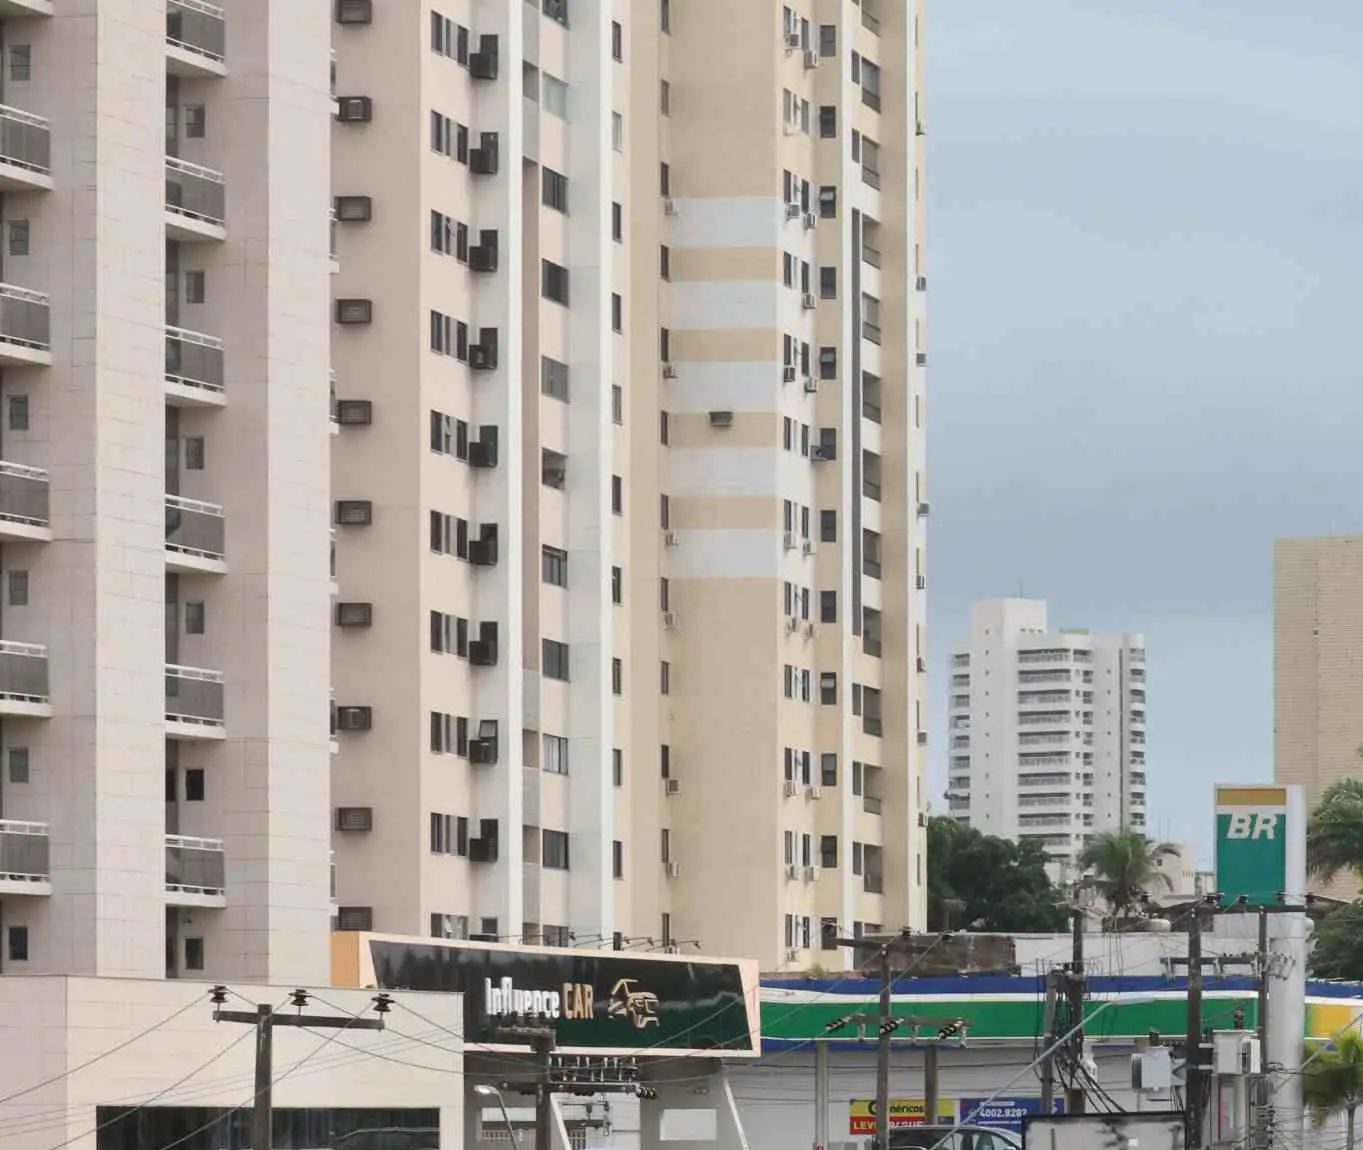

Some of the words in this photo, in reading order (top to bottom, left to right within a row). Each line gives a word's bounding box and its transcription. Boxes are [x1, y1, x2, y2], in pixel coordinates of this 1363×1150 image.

[1227, 812, 1278, 840] BR
[484, 976, 561, 1019] Influence
[562, 981, 595, 1020] CAR
